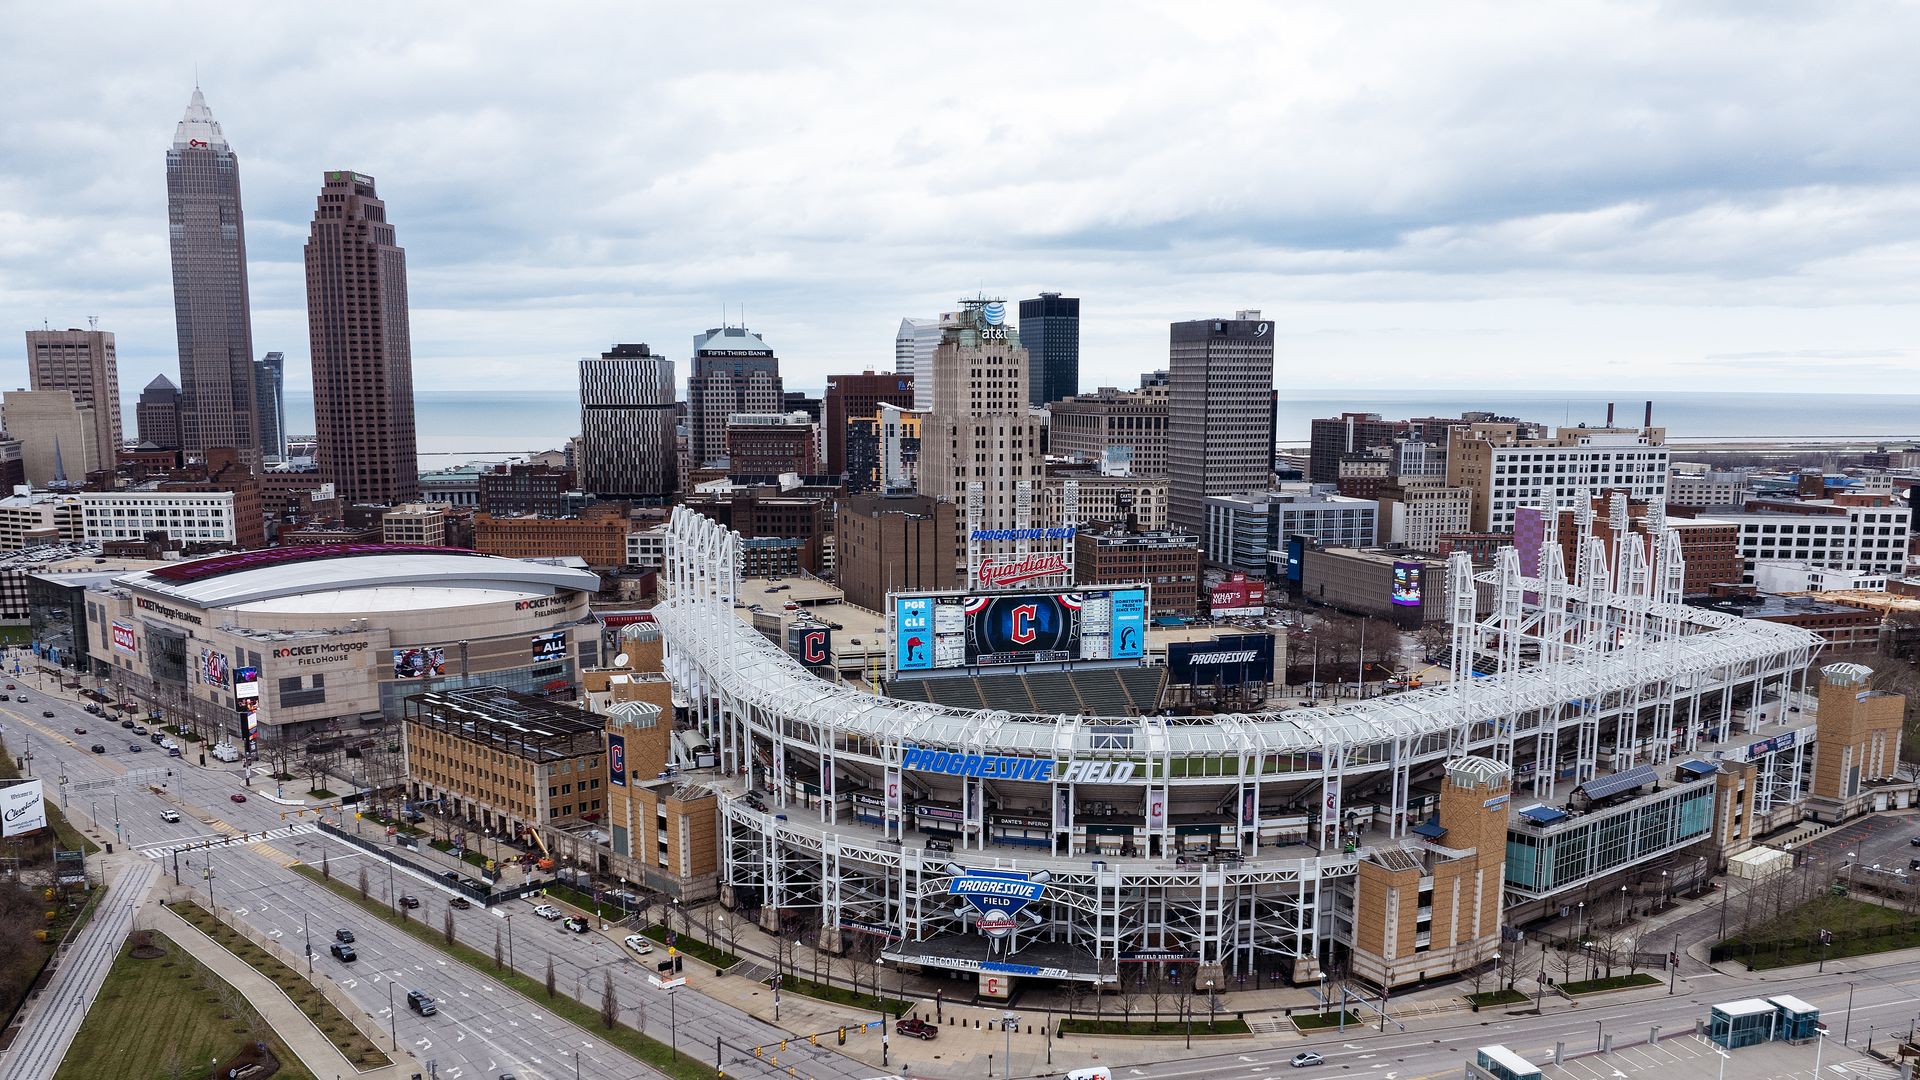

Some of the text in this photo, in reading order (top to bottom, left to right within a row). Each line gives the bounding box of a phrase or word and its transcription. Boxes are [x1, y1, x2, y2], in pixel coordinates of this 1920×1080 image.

[982, 326, 1009, 339] at&t
[970, 527, 1076, 541] PROGRESSIVE FIELD
[978, 553, 1068, 588] Guardians
[515, 597, 549, 611] ROCKET
[1212, 592, 1241, 600] WHAT'S
[904, 600, 926, 610] PGR
[904, 617, 926, 627] CLE
[1011, 604, 1037, 645] C
[272, 641, 369, 659] ROCKET Mortgage
[543, 640, 566, 653] ALL
[805, 631, 826, 664] C
[298, 654, 349, 666] FIELDHOUSE
[1188, 650, 1258, 665] PROGRESSIVE
[611, 744, 623, 773] C
[901, 747, 1136, 784] PROGRESSIVE FIELD
[4, 793, 40, 822] Cleveland
[956, 880, 1036, 898] PROGRESSIVE
[983, 896, 1011, 906] FIELD
[919, 954, 967, 968] WELCOME
[966, 960, 979, 969] TO
[1041, 967, 1069, 978] FIELD
[987, 977, 998, 994] C
